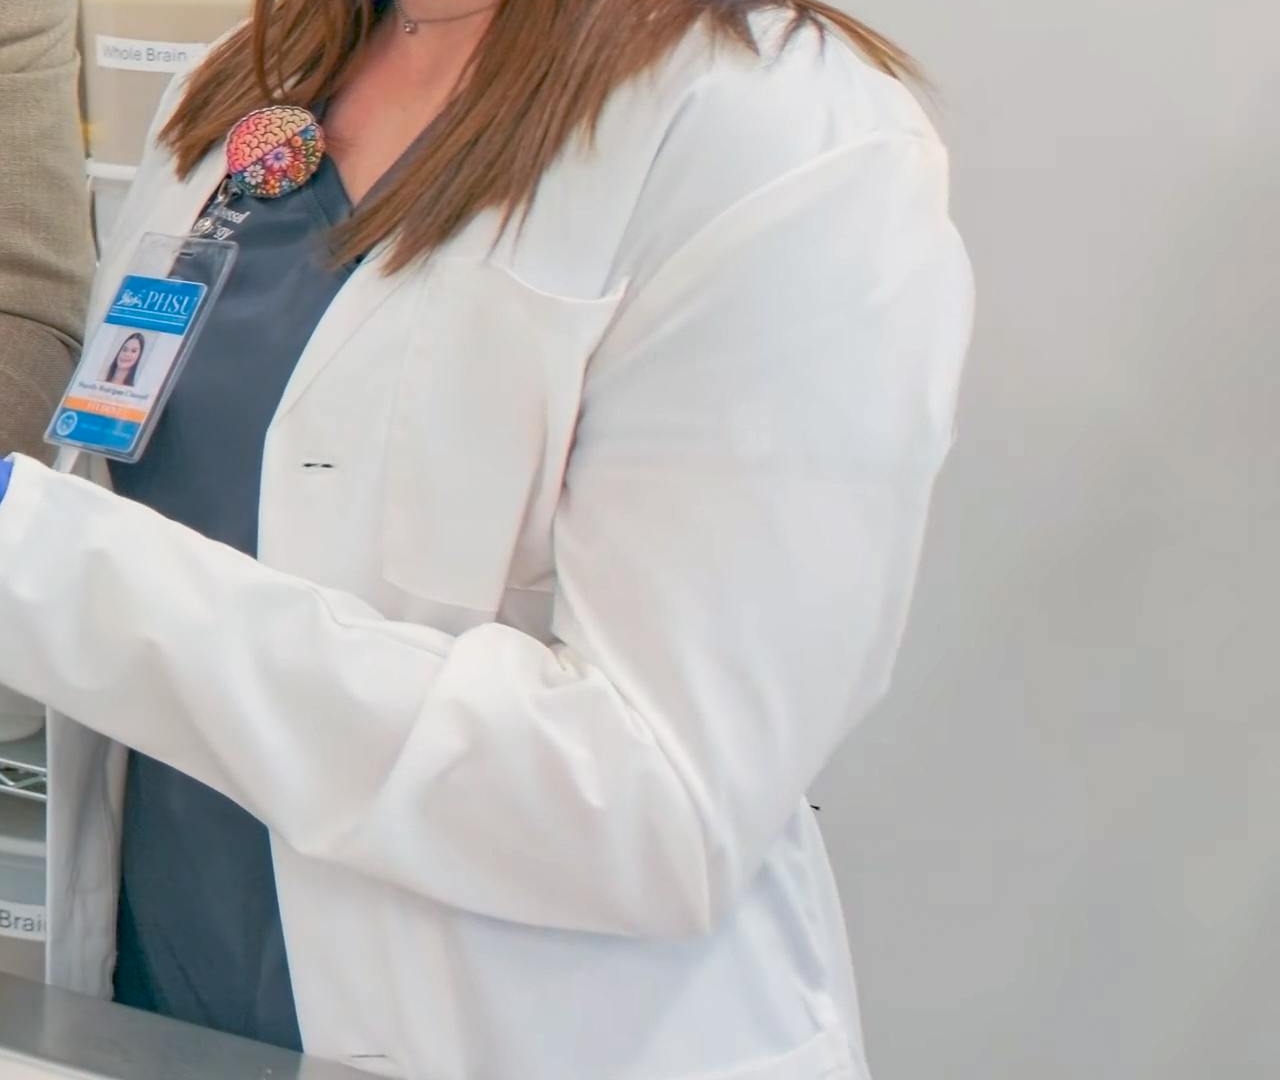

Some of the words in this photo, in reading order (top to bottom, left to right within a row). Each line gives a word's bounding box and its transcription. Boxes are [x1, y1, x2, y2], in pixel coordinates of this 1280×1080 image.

[103, 43, 142, 62] Whole
[146, 46, 187, 62] Brain
[143, 290, 199, 316] PHSU
